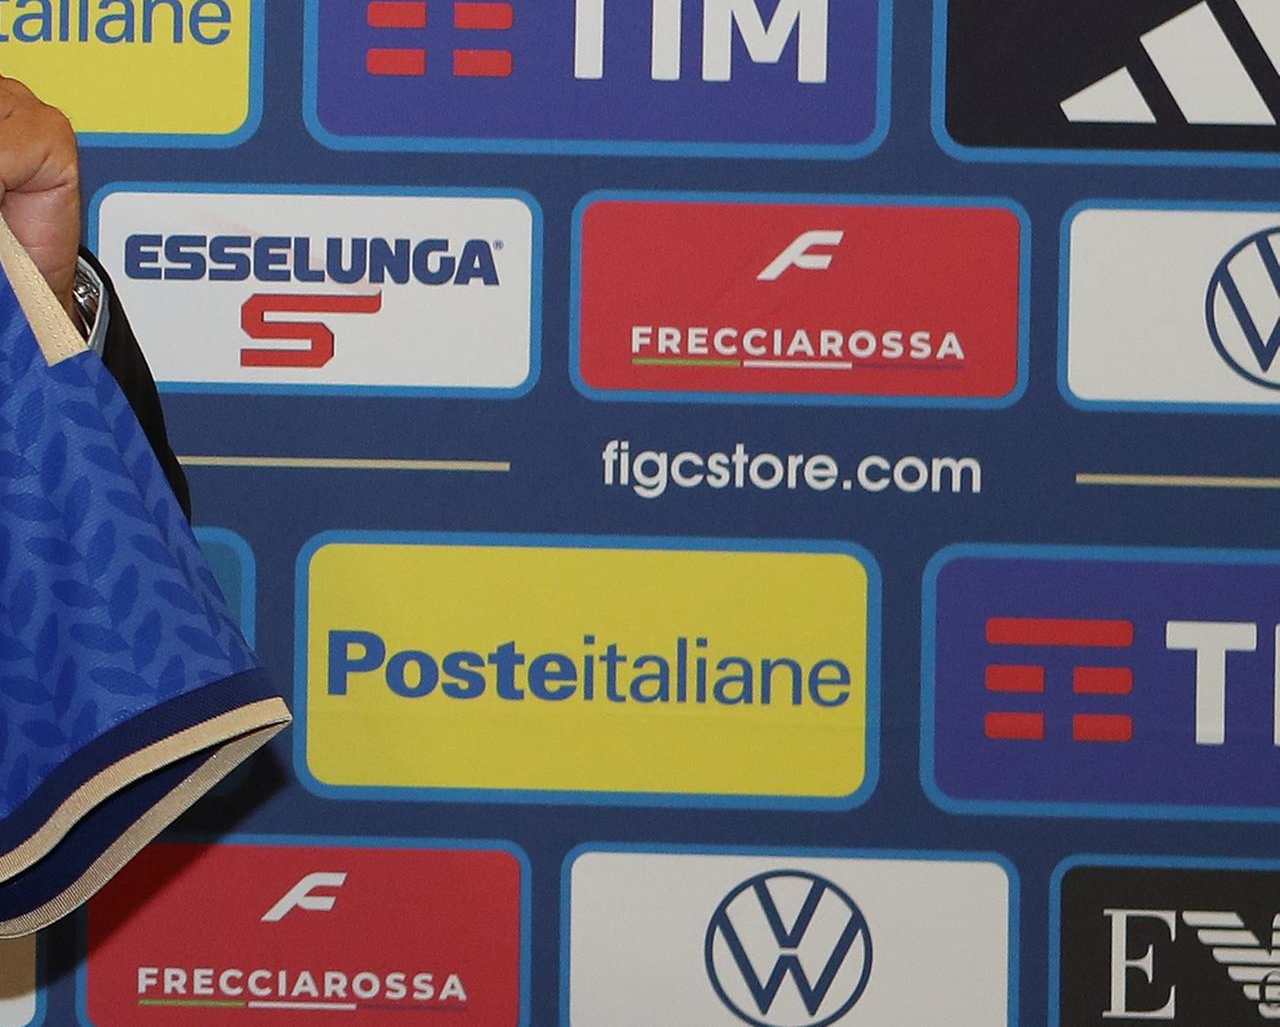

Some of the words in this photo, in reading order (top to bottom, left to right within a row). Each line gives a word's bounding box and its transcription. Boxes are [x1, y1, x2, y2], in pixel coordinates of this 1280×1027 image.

[124, 234, 500, 286] ESSELUNGA
[632, 325, 966, 360] FRECCIAROSSA
[603, 440, 981, 498] figcstore.com
[138, 967, 468, 1002] FRECCIAROSSA
